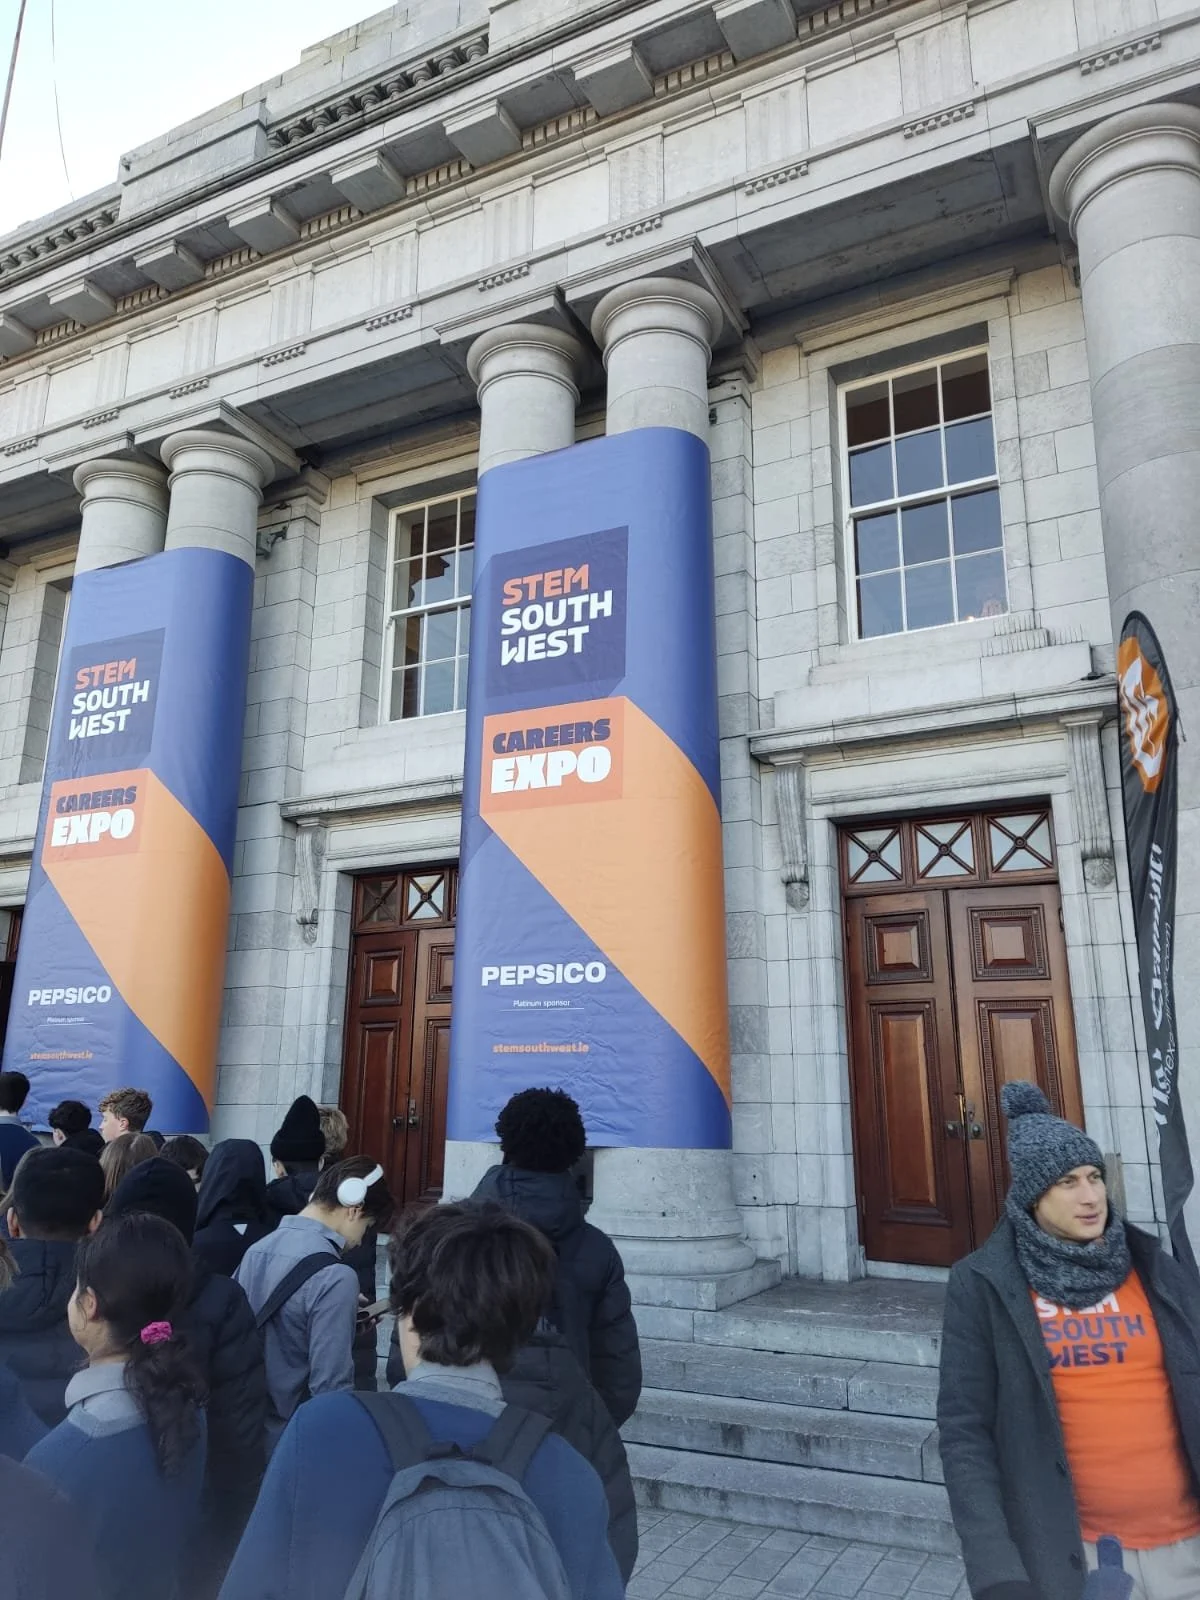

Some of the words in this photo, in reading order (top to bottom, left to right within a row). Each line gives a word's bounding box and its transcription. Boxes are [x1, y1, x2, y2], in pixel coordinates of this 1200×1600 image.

[502, 563, 589, 605] STEM
[501, 590, 613, 635] SOUTH
[501, 625, 590, 666] WEST
[75, 657, 137, 690] STEM
[71, 679, 150, 715] SOUTH
[68, 708, 132, 741] WEST
[492, 718, 611, 754] CAREERS
[490, 745, 612, 794] EXPO
[56, 786, 138, 814] CAREERS
[51, 808, 136, 847] EXPO
[481, 961, 607, 986] PEPSICO
[27, 985, 112, 1006] PEPSICO
[513, 999, 542, 1008] Platinum
[543, 999, 570, 1008] sponsor
[1035, 1291, 1120, 1318] SM
[1041, 1314, 1146, 1343] SOUTH
